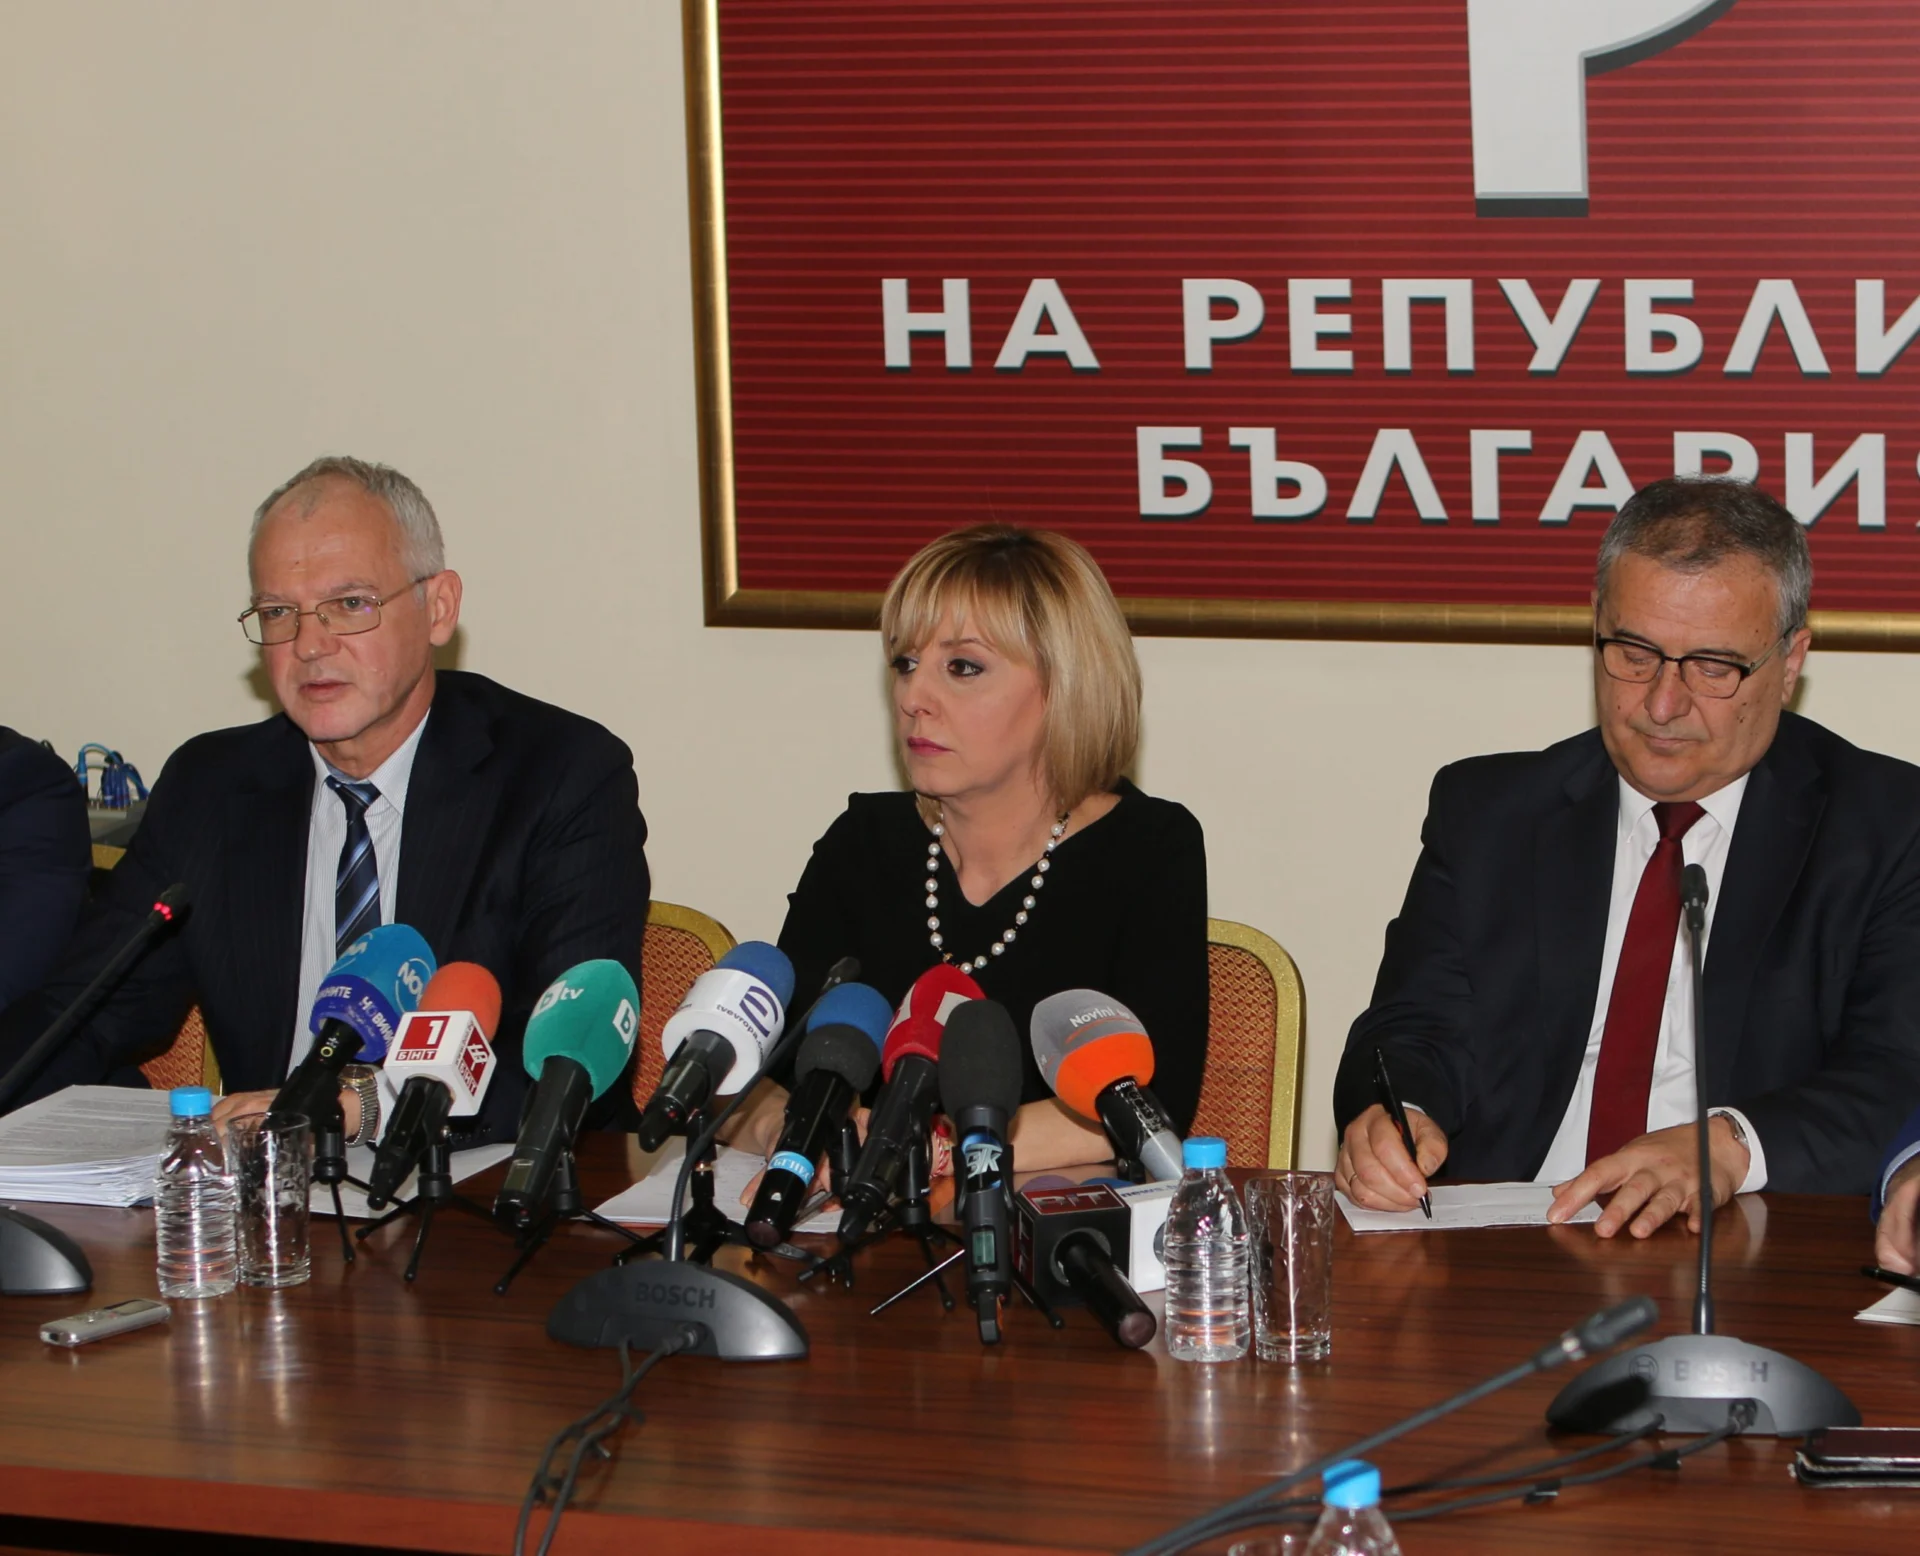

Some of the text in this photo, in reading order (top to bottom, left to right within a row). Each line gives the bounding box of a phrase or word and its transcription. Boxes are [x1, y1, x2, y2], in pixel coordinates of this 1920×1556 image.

[881, 277, 1101, 371] НА
[1136, 425, 1920, 530] БЪЛГАРИ
[426, 1019, 445, 1046] 1
[396, 1050, 437, 1062] БНТ
[635, 1281, 717, 1309] BOSCH
